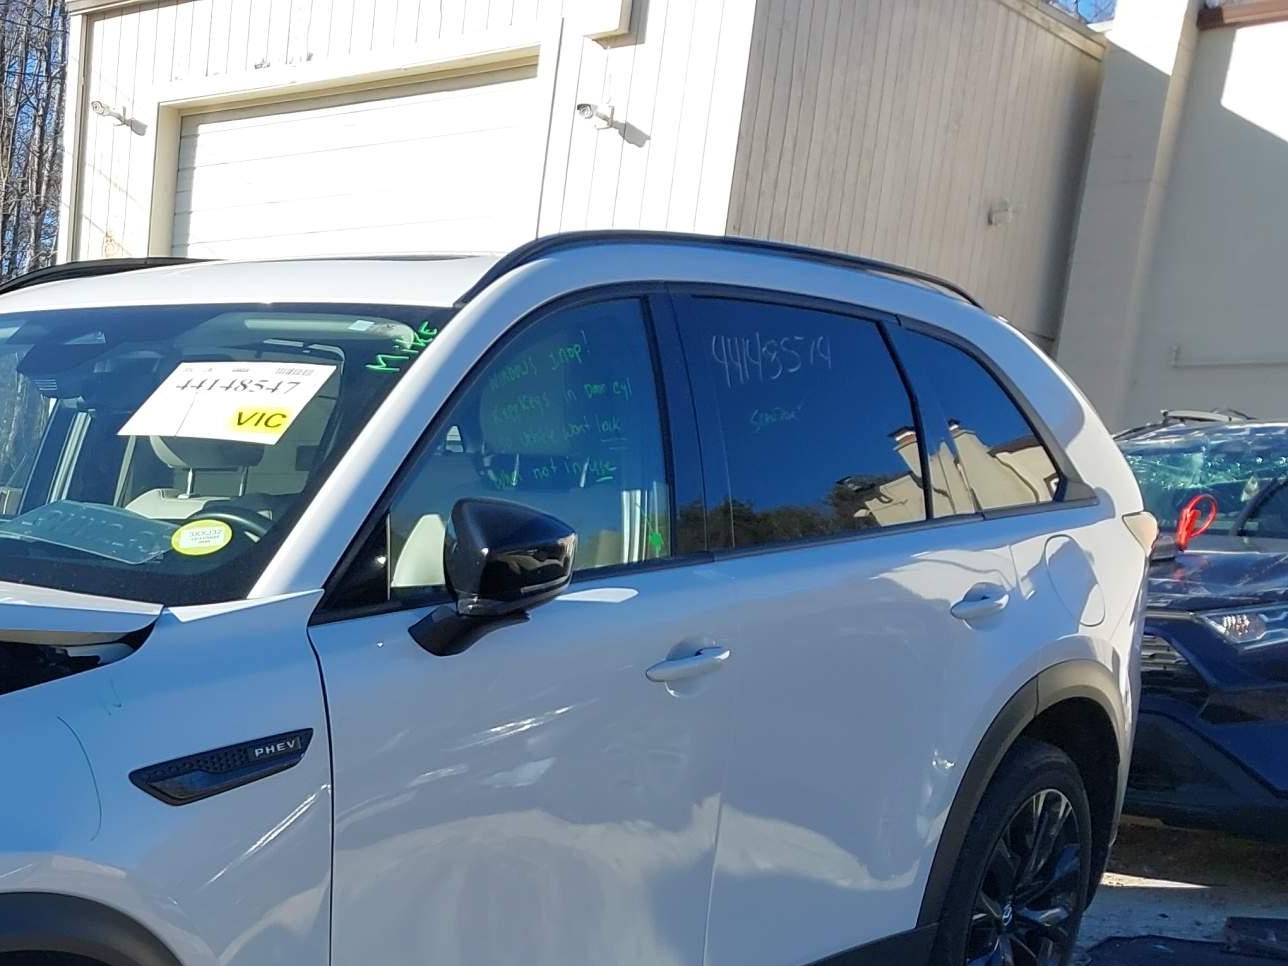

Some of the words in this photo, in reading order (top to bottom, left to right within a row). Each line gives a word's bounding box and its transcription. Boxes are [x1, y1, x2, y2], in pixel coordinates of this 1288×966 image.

[175, 377, 304, 395] 44148547
[236, 411, 288, 429] VIC
[254, 739, 295, 757] PHEV
